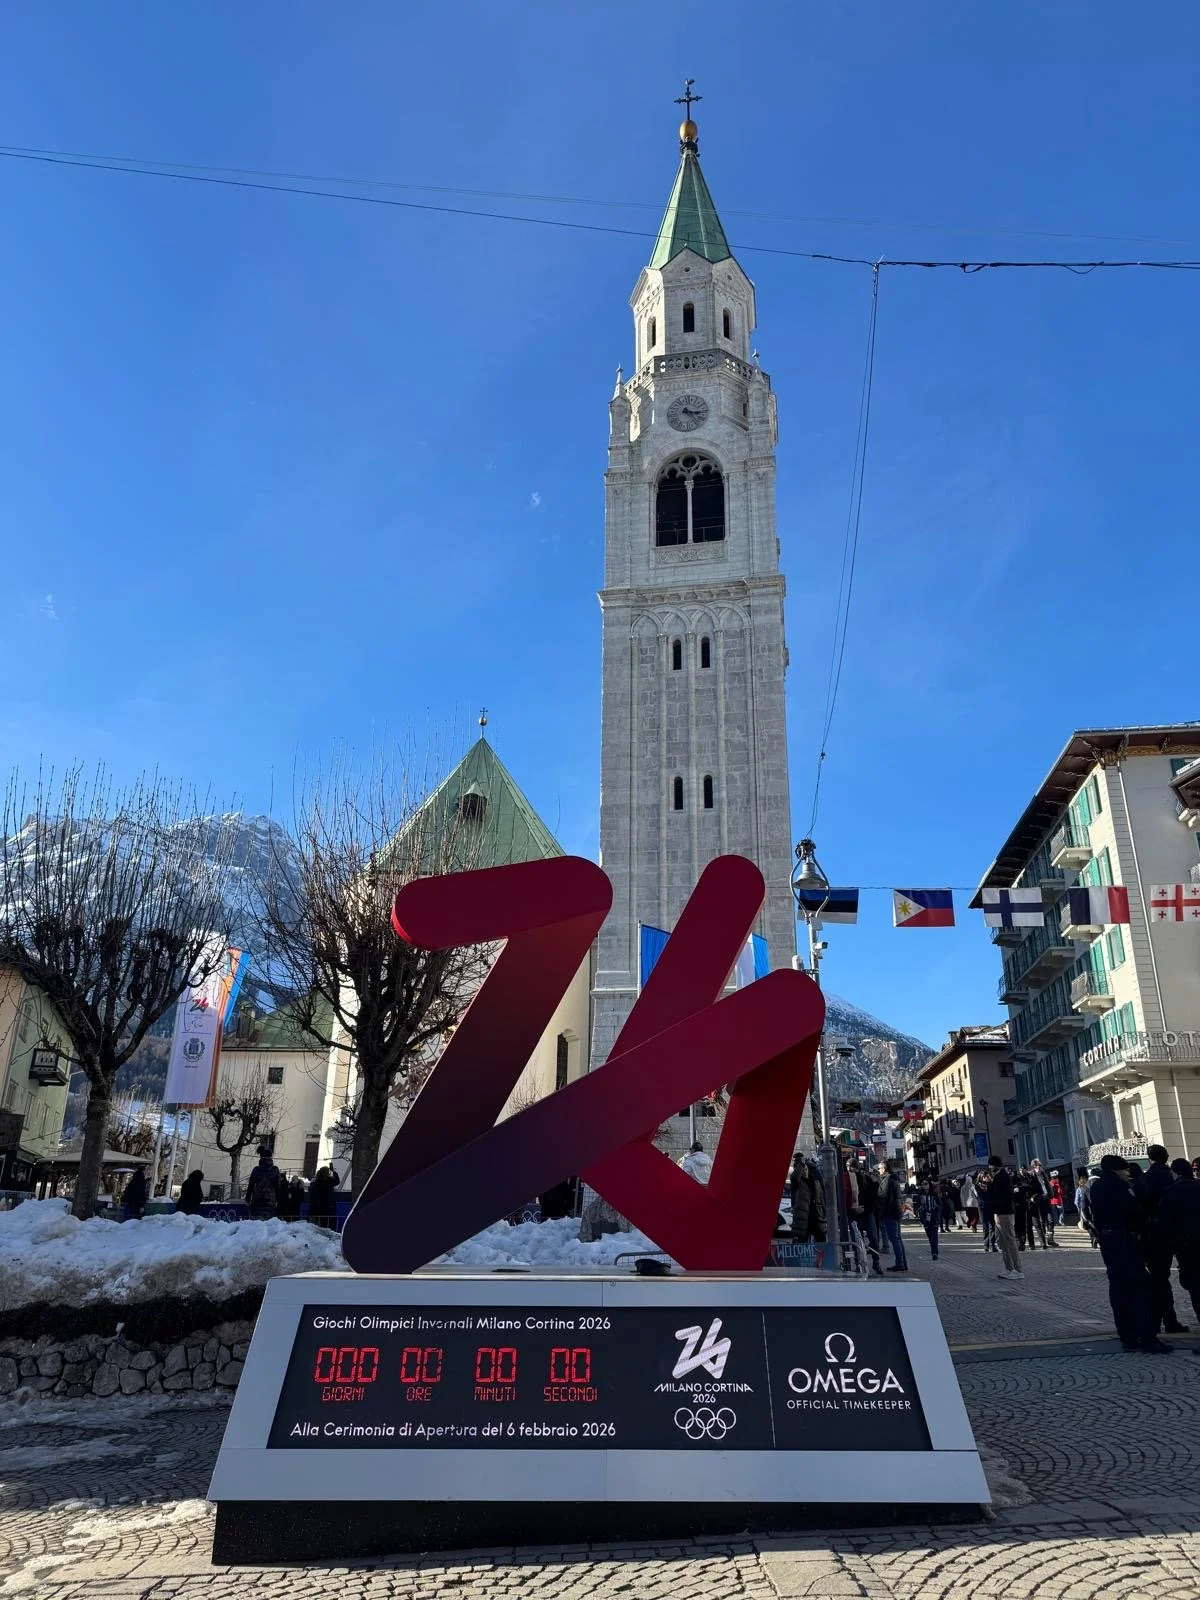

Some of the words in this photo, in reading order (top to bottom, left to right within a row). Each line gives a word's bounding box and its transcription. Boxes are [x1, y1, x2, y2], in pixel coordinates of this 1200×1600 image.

[1083, 1035, 1120, 1067] CORTINA
[777, 1244, 817, 1258] WELCOME
[313, 1316, 356, 1329] Giochi
[360, 1316, 415, 1333] Olimpici
[476, 1317, 521, 1330] Milano
[525, 1317, 575, 1330] Cortina
[578, 1317, 611, 1330] 2026
[314, 1347, 380, 1383] 000
[400, 1347, 443, 1383] 00
[475, 1347, 517, 1383] 00
[550, 1347, 591, 1383] 00
[653, 1382, 702, 1393] MILANO
[704, 1382, 754, 1393] CORTINA
[787, 1367, 905, 1394] OMEGA
[322, 1386, 365, 1402] GIORNI
[406, 1386, 432, 1402] ORE
[474, 1386, 516, 1402] MINUTI
[543, 1386, 598, 1402] SECONDI
[692, 1393, 716, 1404] 2026
[786, 1399, 840, 1410] OFFICIAL
[843, 1399, 912, 1411] TIMEKEEPER
[290, 1422, 319, 1437] Alla
[324, 1422, 395, 1437] Cerimonia
[399, 1422, 412, 1437] di
[415, 1422, 477, 1441] Apertura
[481, 1422, 503, 1437] del
[506, 1422, 515, 1437] 6
[519, 1422, 578, 1437] febbraio
[582, 1422, 616, 1437] 2026
